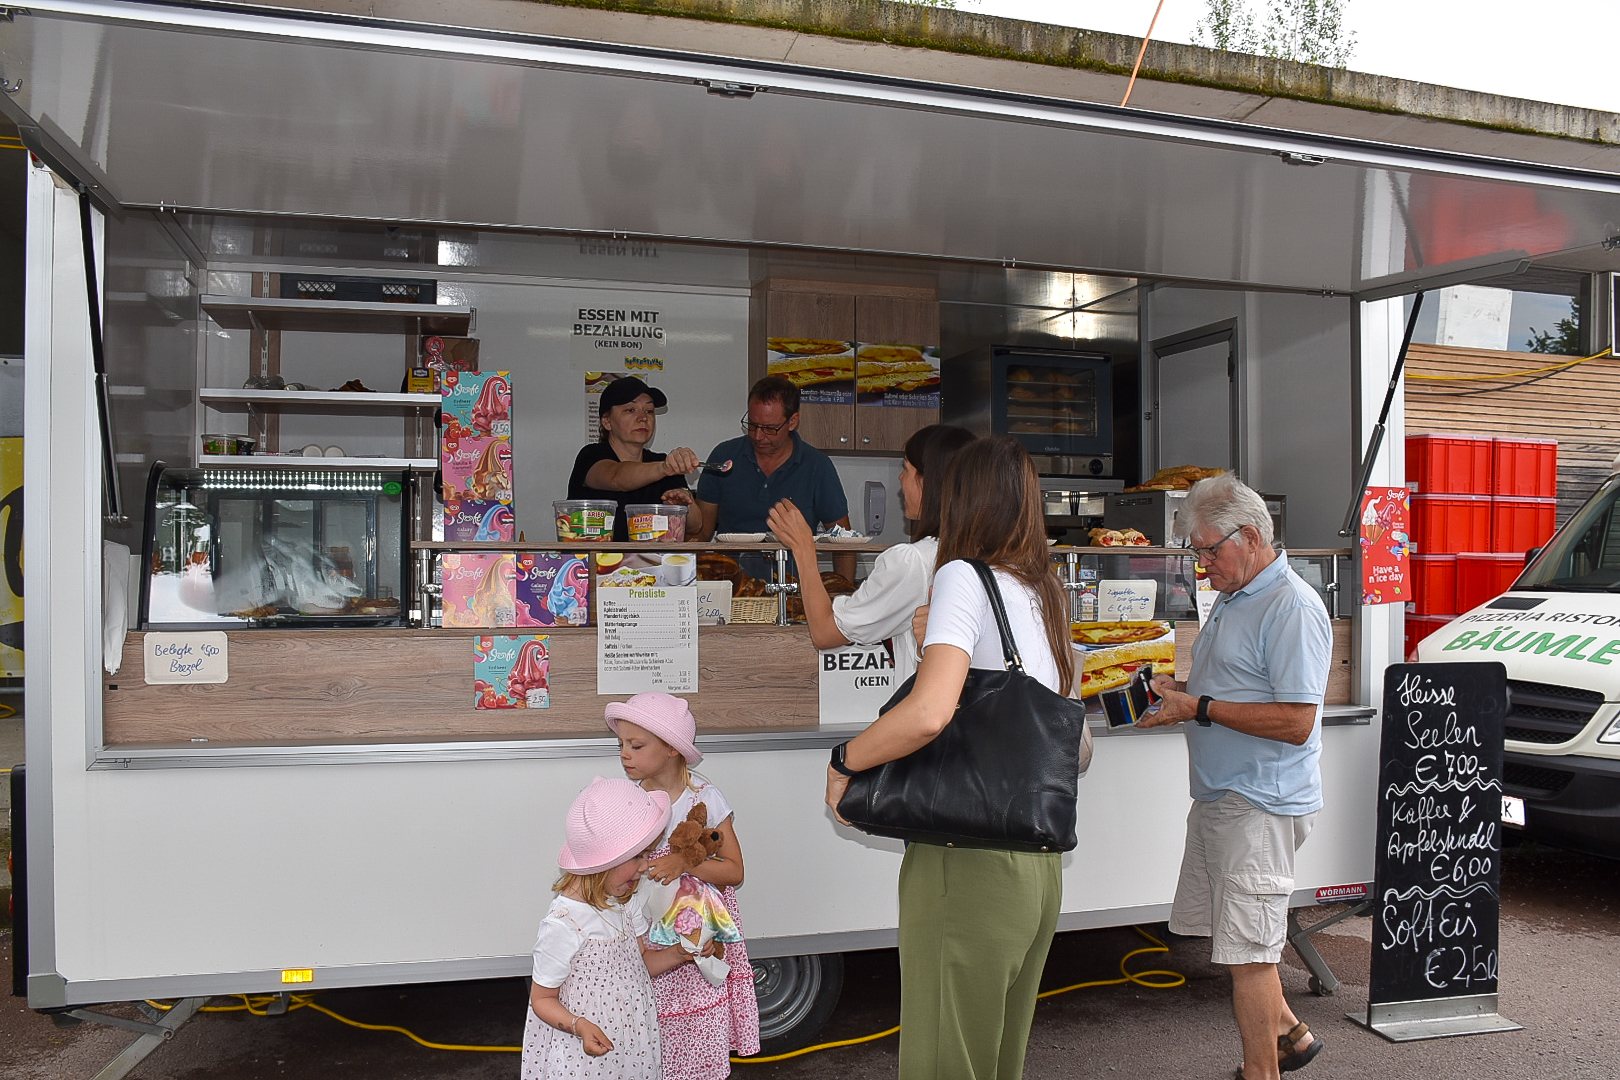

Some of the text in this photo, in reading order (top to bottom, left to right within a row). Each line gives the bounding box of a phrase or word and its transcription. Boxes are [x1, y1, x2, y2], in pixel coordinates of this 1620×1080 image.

[578, 309, 659, 323] ESSEN MIT
[573, 324, 663, 339] BEZAHLUNG
[595, 340, 643, 350] (KEIN BON)
[1373, 566, 1393, 575] Have
[1389, 572, 1404, 583] day
[629, 589, 666, 598] Preisliste
[1460, 613, 1546, 624] PIZZERIA
[155, 643, 193, 659] Belegte
[1442, 626, 1620, 665] BÄUMLE
[169, 659, 205, 677] Brezel
[855, 676, 889, 690] (KEIN
[1397, 673, 1457, 707] Heisse
[1405, 711, 1482, 749] Seelen
[1416, 754, 1439, 784] €
[1392, 796, 1453, 830] Kaffee
[1459, 795, 1477, 823] &
[1431, 853, 1492, 887] € 6,00
[1320, 887, 1363, 897] WÖRMANN
[1382, 900, 1477, 953] Soft Eis
[1424, 948, 1449, 989] €
